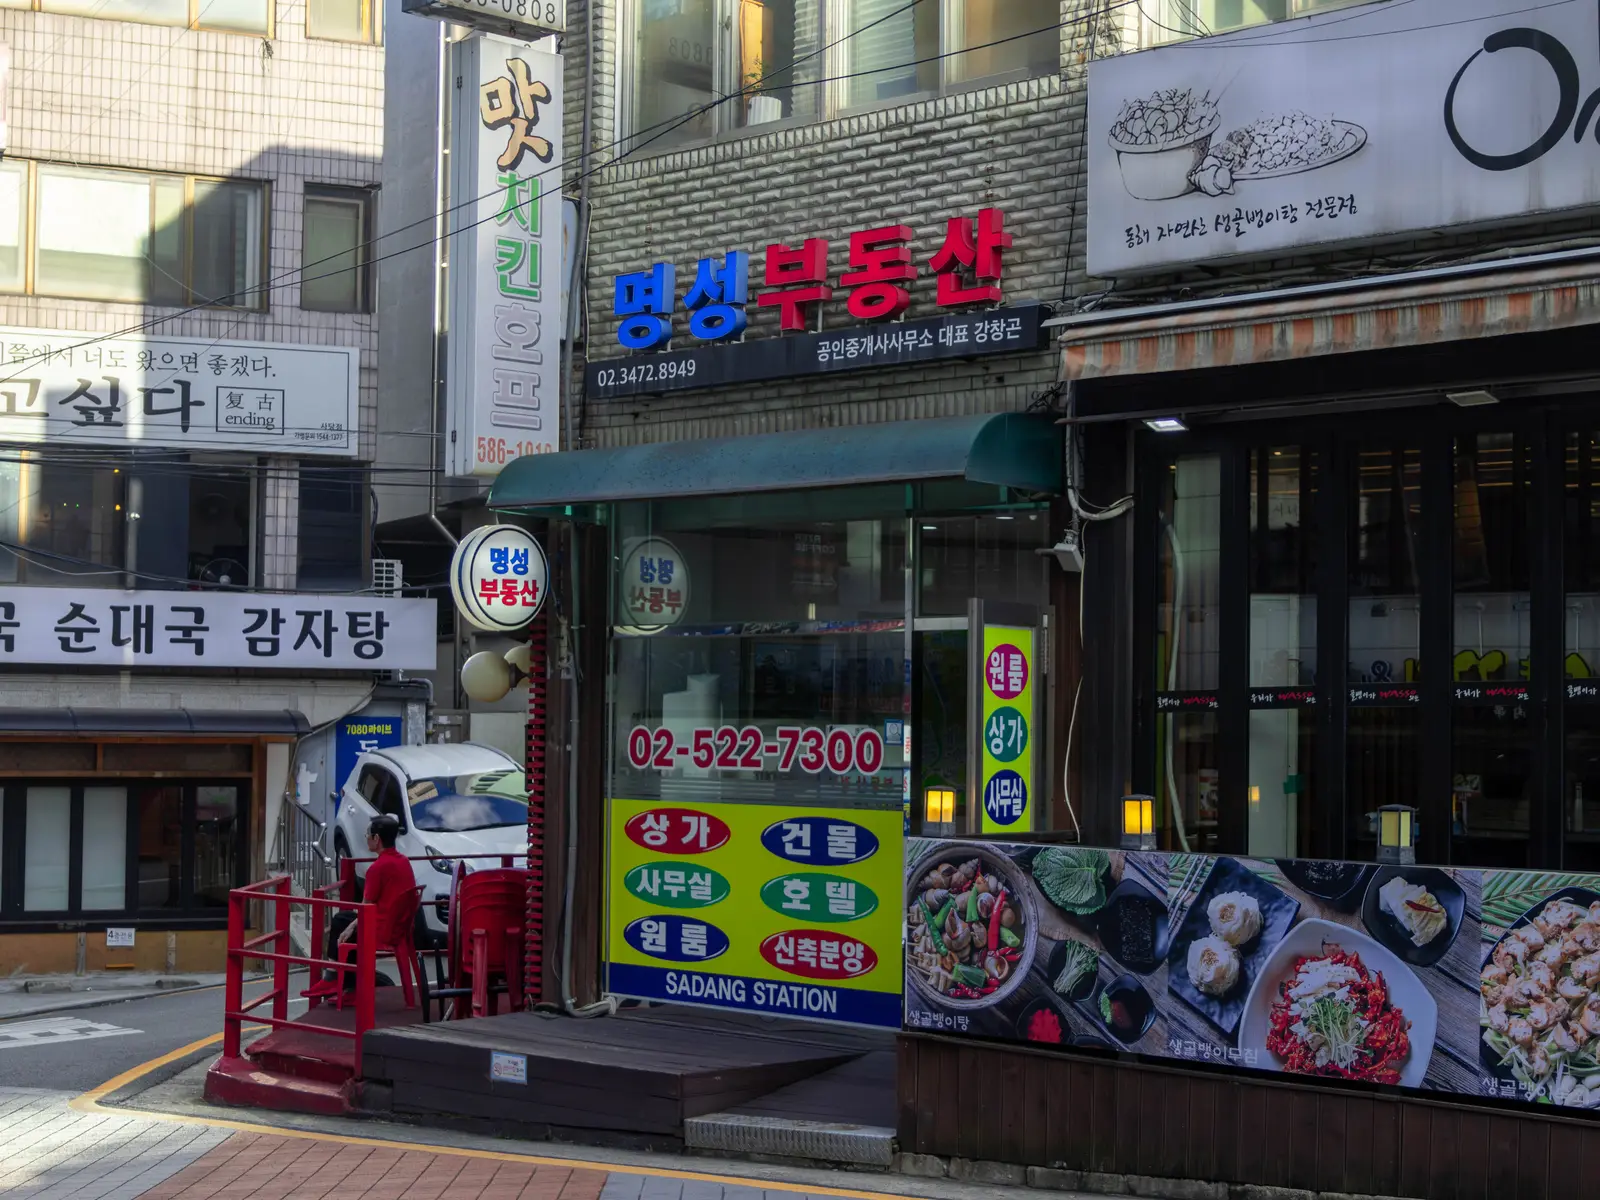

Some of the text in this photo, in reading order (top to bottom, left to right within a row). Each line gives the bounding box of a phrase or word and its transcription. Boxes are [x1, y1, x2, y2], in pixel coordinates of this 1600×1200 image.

[1125, 194, 1358, 248] 동해 자연산 생골뱅이탕 전문점
[613, 207, 1013, 350] 명성 부동산
[816, 316, 1022, 362] 공인중개사사무소 대표 강창곤
[0, 342, 277, 378] 쯤에서 너도 왔으면 좋겠다.
[597, 359, 697, 388] 02.3472.8949
[225, 412, 276, 431] ending
[489, 547, 530, 576] 명성
[479, 578, 539, 607] 부동산
[54, 602, 210, 656] 순대국
[242, 607, 391, 660] 감자탕
[989, 651, 1024, 692] 원룸
[345, 724, 393, 735] 7080라이브
[988, 715, 1023, 756] 상가
[628, 725, 883, 775] 02-522-7300
[987, 777, 1023, 818] 사무실
[640, 813, 711, 848] 상가
[781, 822, 857, 859] 건물
[636, 868, 712, 901] 사무실
[781, 878, 856, 916] 호텔
[639, 919, 707, 957] 원룸
[773, 935, 865, 974] 신축분양
[665, 971, 837, 1014] SADANG STATION
[908, 1010, 970, 1031] 생골뱅이탕
[1168, 1039, 1258, 1065] 생골뱅이무침
